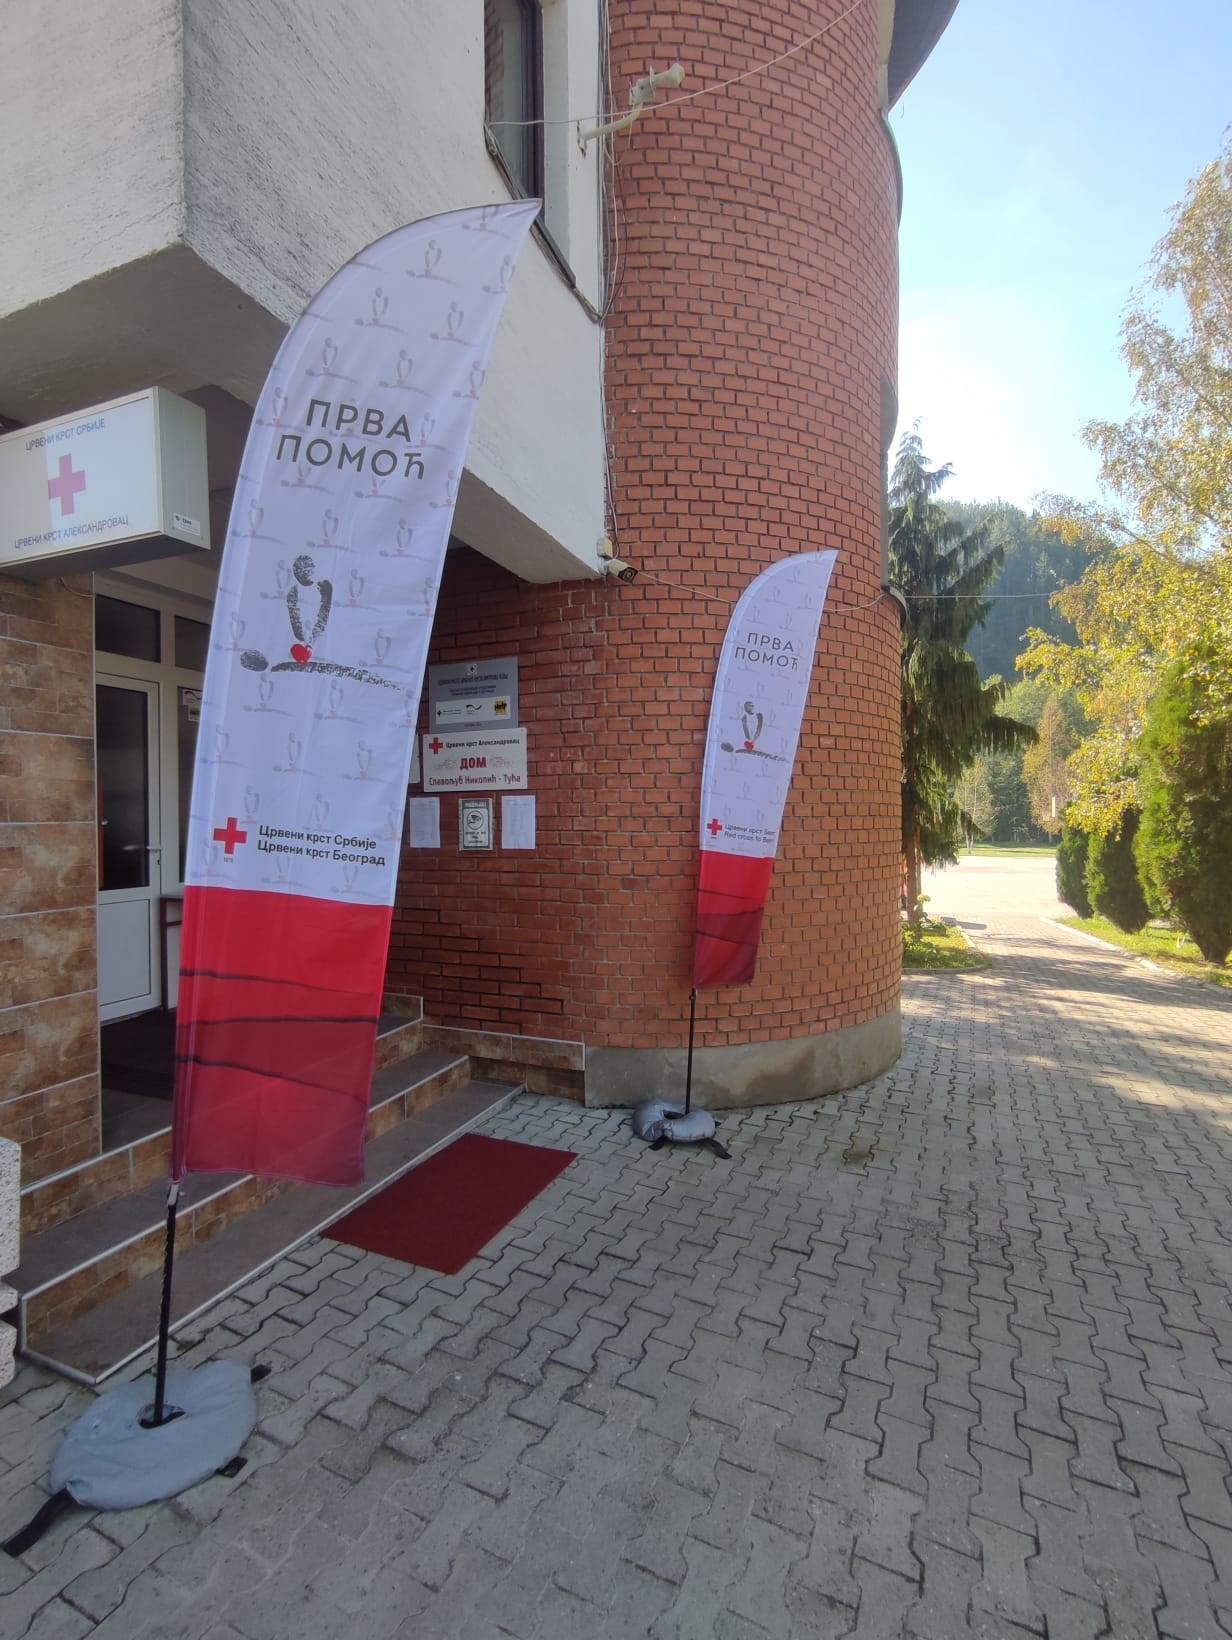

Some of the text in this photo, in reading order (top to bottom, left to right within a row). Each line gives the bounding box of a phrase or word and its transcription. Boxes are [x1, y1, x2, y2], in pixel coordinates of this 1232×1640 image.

[306, 399, 412, 443] ПРВА
[26, 418, 105, 451] ЦРВЕНИ КРСТ СРБИЈЕ
[275, 434, 425, 480] ПОМОЋ
[15, 515, 128, 549] ЦРВЕНИ КРСТ АЛЕКСАНДРОВАЦ
[747, 632, 794, 653] ПРВА
[734, 647, 799, 671] ПОМОЋ
[478, 738, 520, 747] Александровац
[460, 757, 487, 770] ДОМ
[429, 775, 463, 786] Славољуб
[465, 773, 496, 784] Николић
[503, 773, 521, 783] Тућа
[259, 825, 377, 850] Црвени крст Србије
[257, 840, 386, 866] Црвени крст Београд
